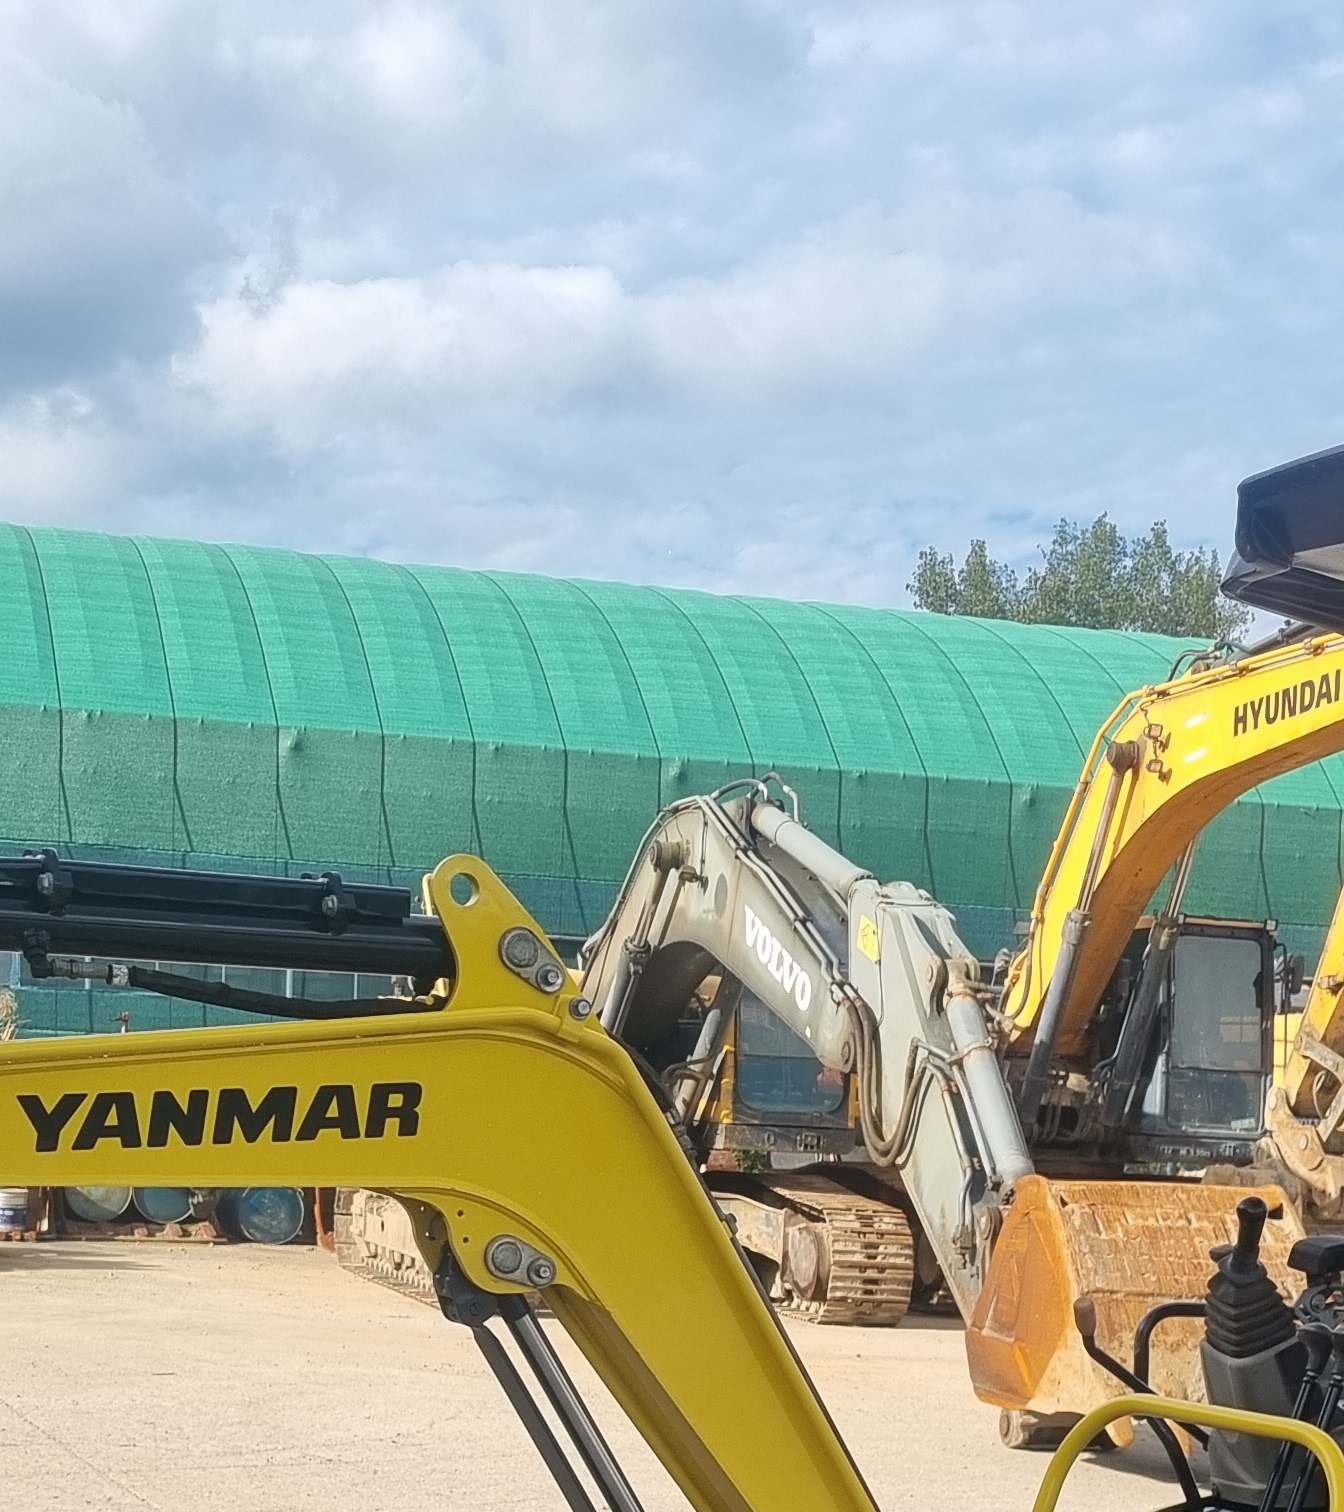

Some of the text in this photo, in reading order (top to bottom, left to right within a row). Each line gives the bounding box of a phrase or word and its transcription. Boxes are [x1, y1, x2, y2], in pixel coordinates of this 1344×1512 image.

[1233, 668, 1341, 738] HYUNDAI
[744, 904, 812, 1011] VOLVO
[15, 1081, 423, 1153] YANMAR
